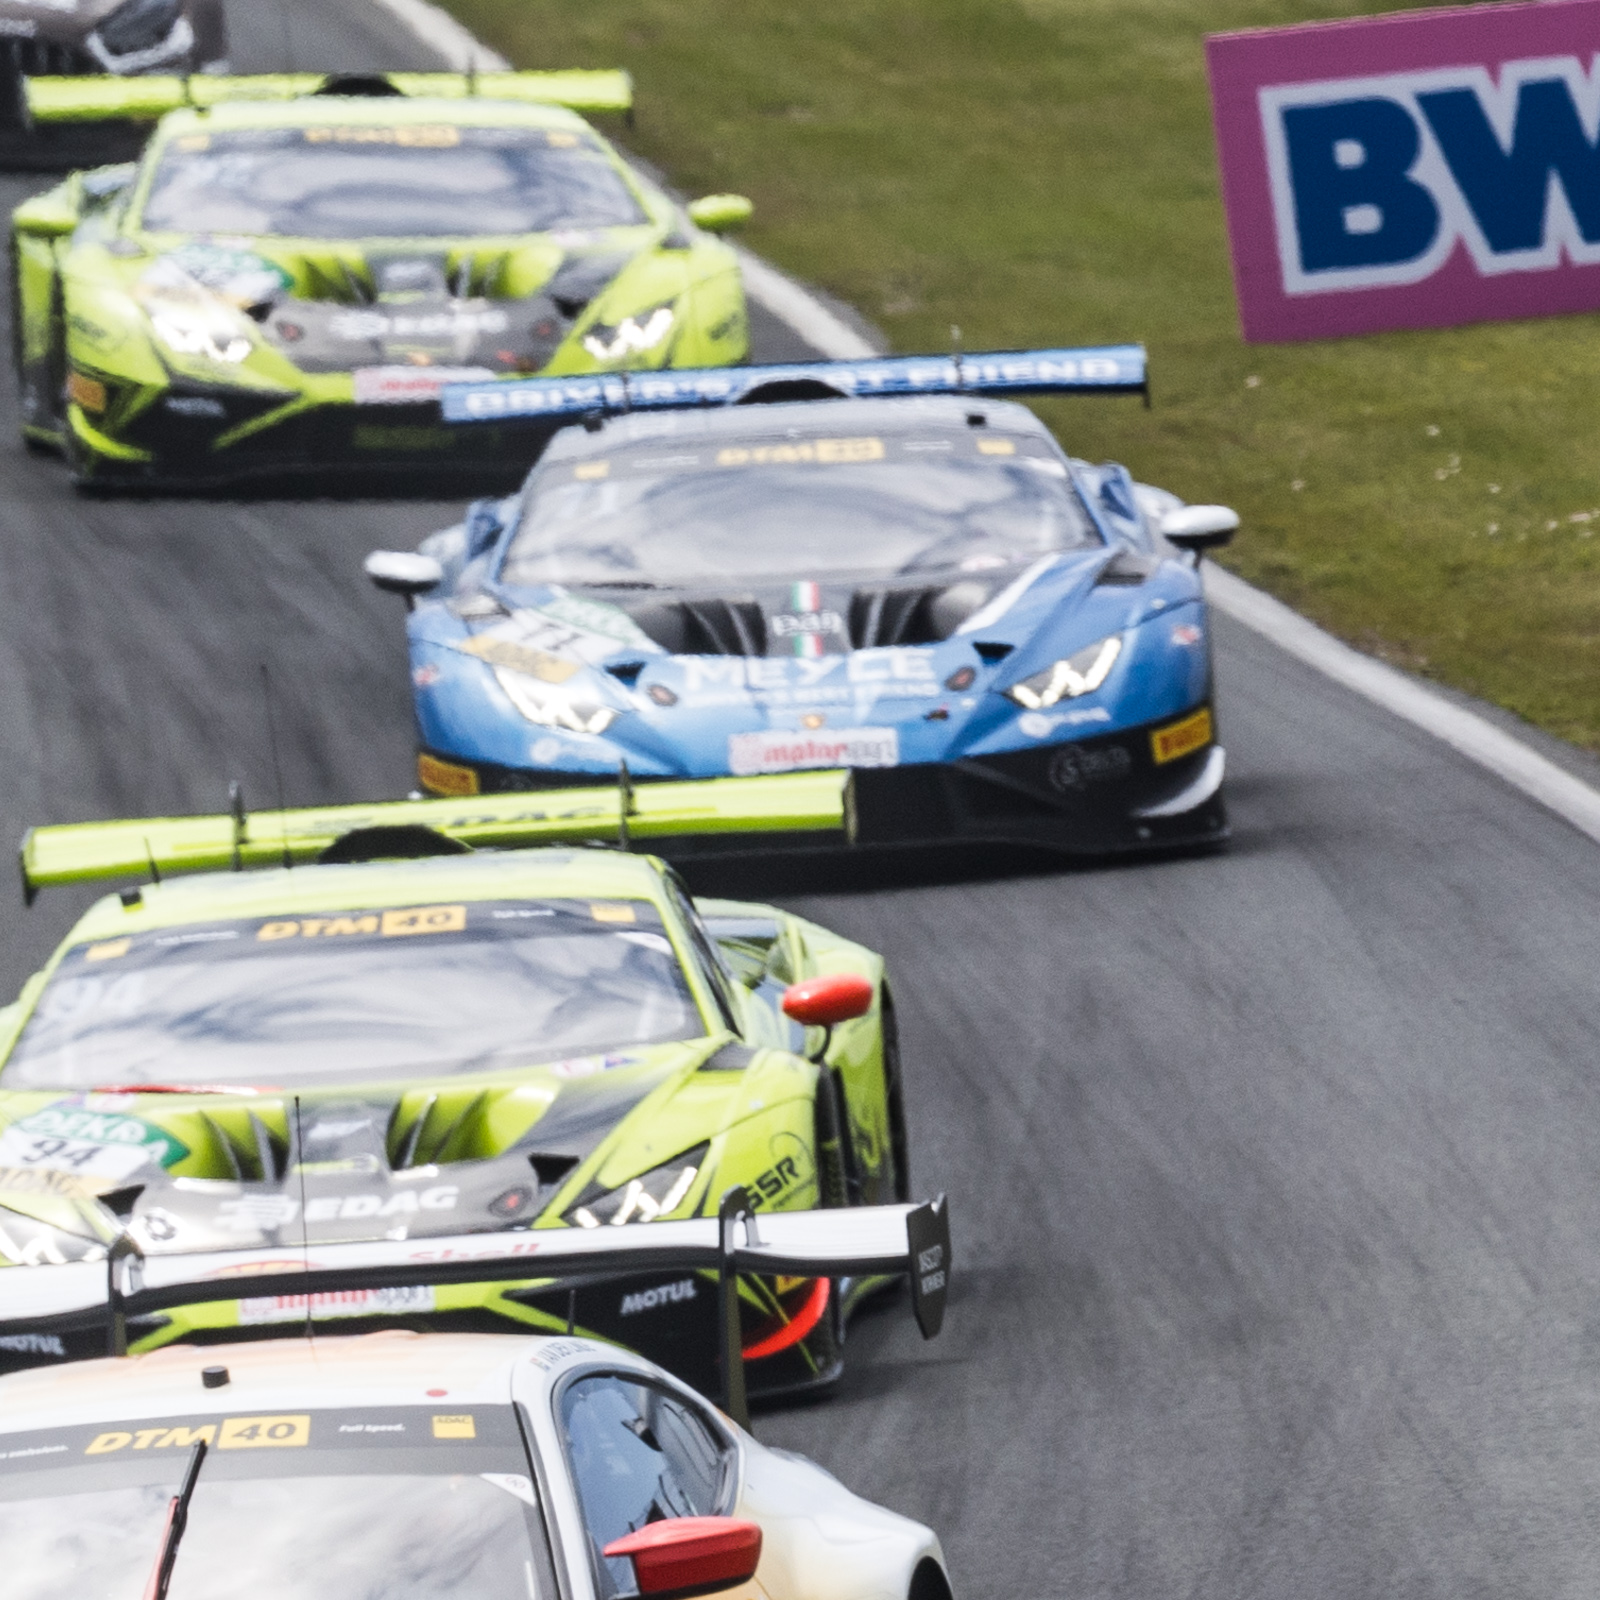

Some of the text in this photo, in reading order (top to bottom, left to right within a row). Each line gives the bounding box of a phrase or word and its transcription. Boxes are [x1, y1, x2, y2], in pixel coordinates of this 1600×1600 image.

[256, 916, 379, 941] DTM
[302, 1186, 459, 1220] EDAG
[620, 1278, 698, 1317] MOTUL
[84, 1425, 217, 1455] DTM
[230, 1422, 297, 1441] 40
